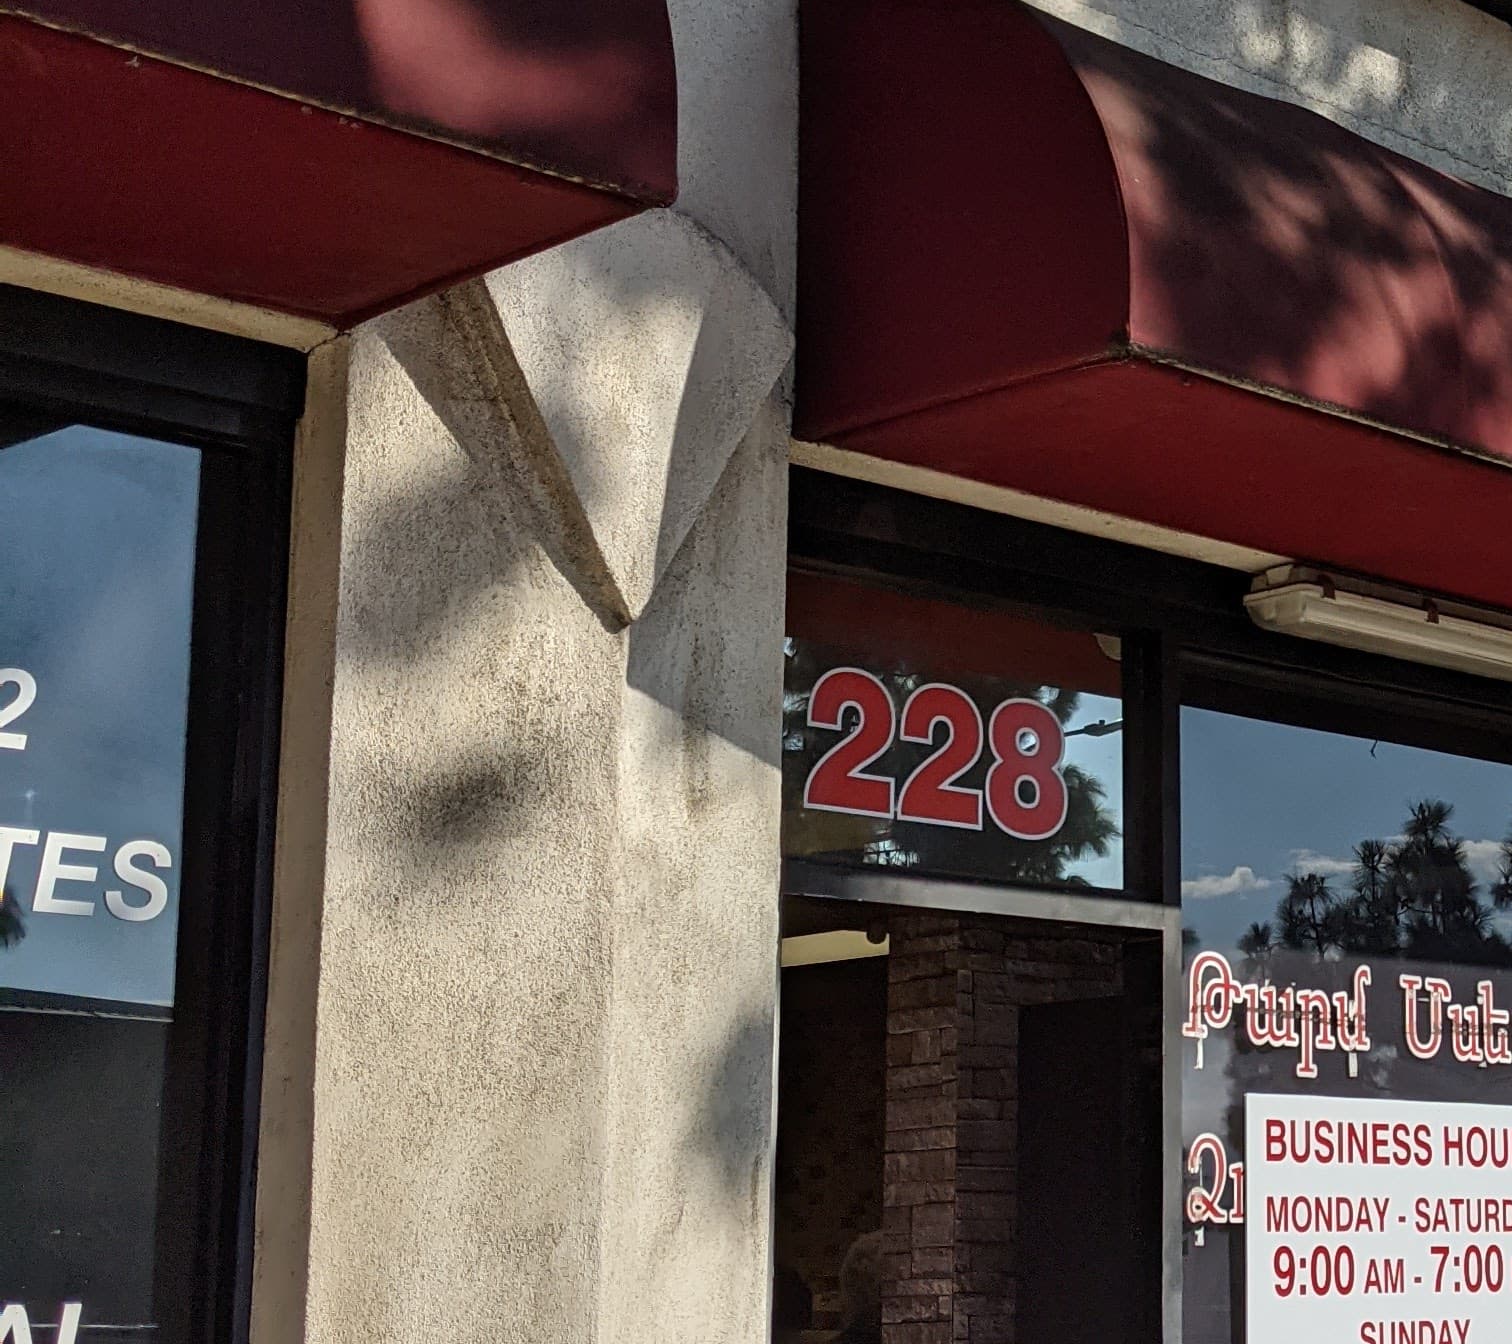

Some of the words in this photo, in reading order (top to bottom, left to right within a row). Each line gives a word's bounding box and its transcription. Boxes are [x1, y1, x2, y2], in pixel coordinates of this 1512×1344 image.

[803, 666, 1069, 841] 228
[1265, 1119, 1433, 1166] BUSINESS
[1265, 1196, 1390, 1233] MONDAY
[1273, 1245, 1355, 1297] 9:00
[1364, 1259, 1405, 1294] AM
[1430, 1244, 1501, 1295] 7:00
